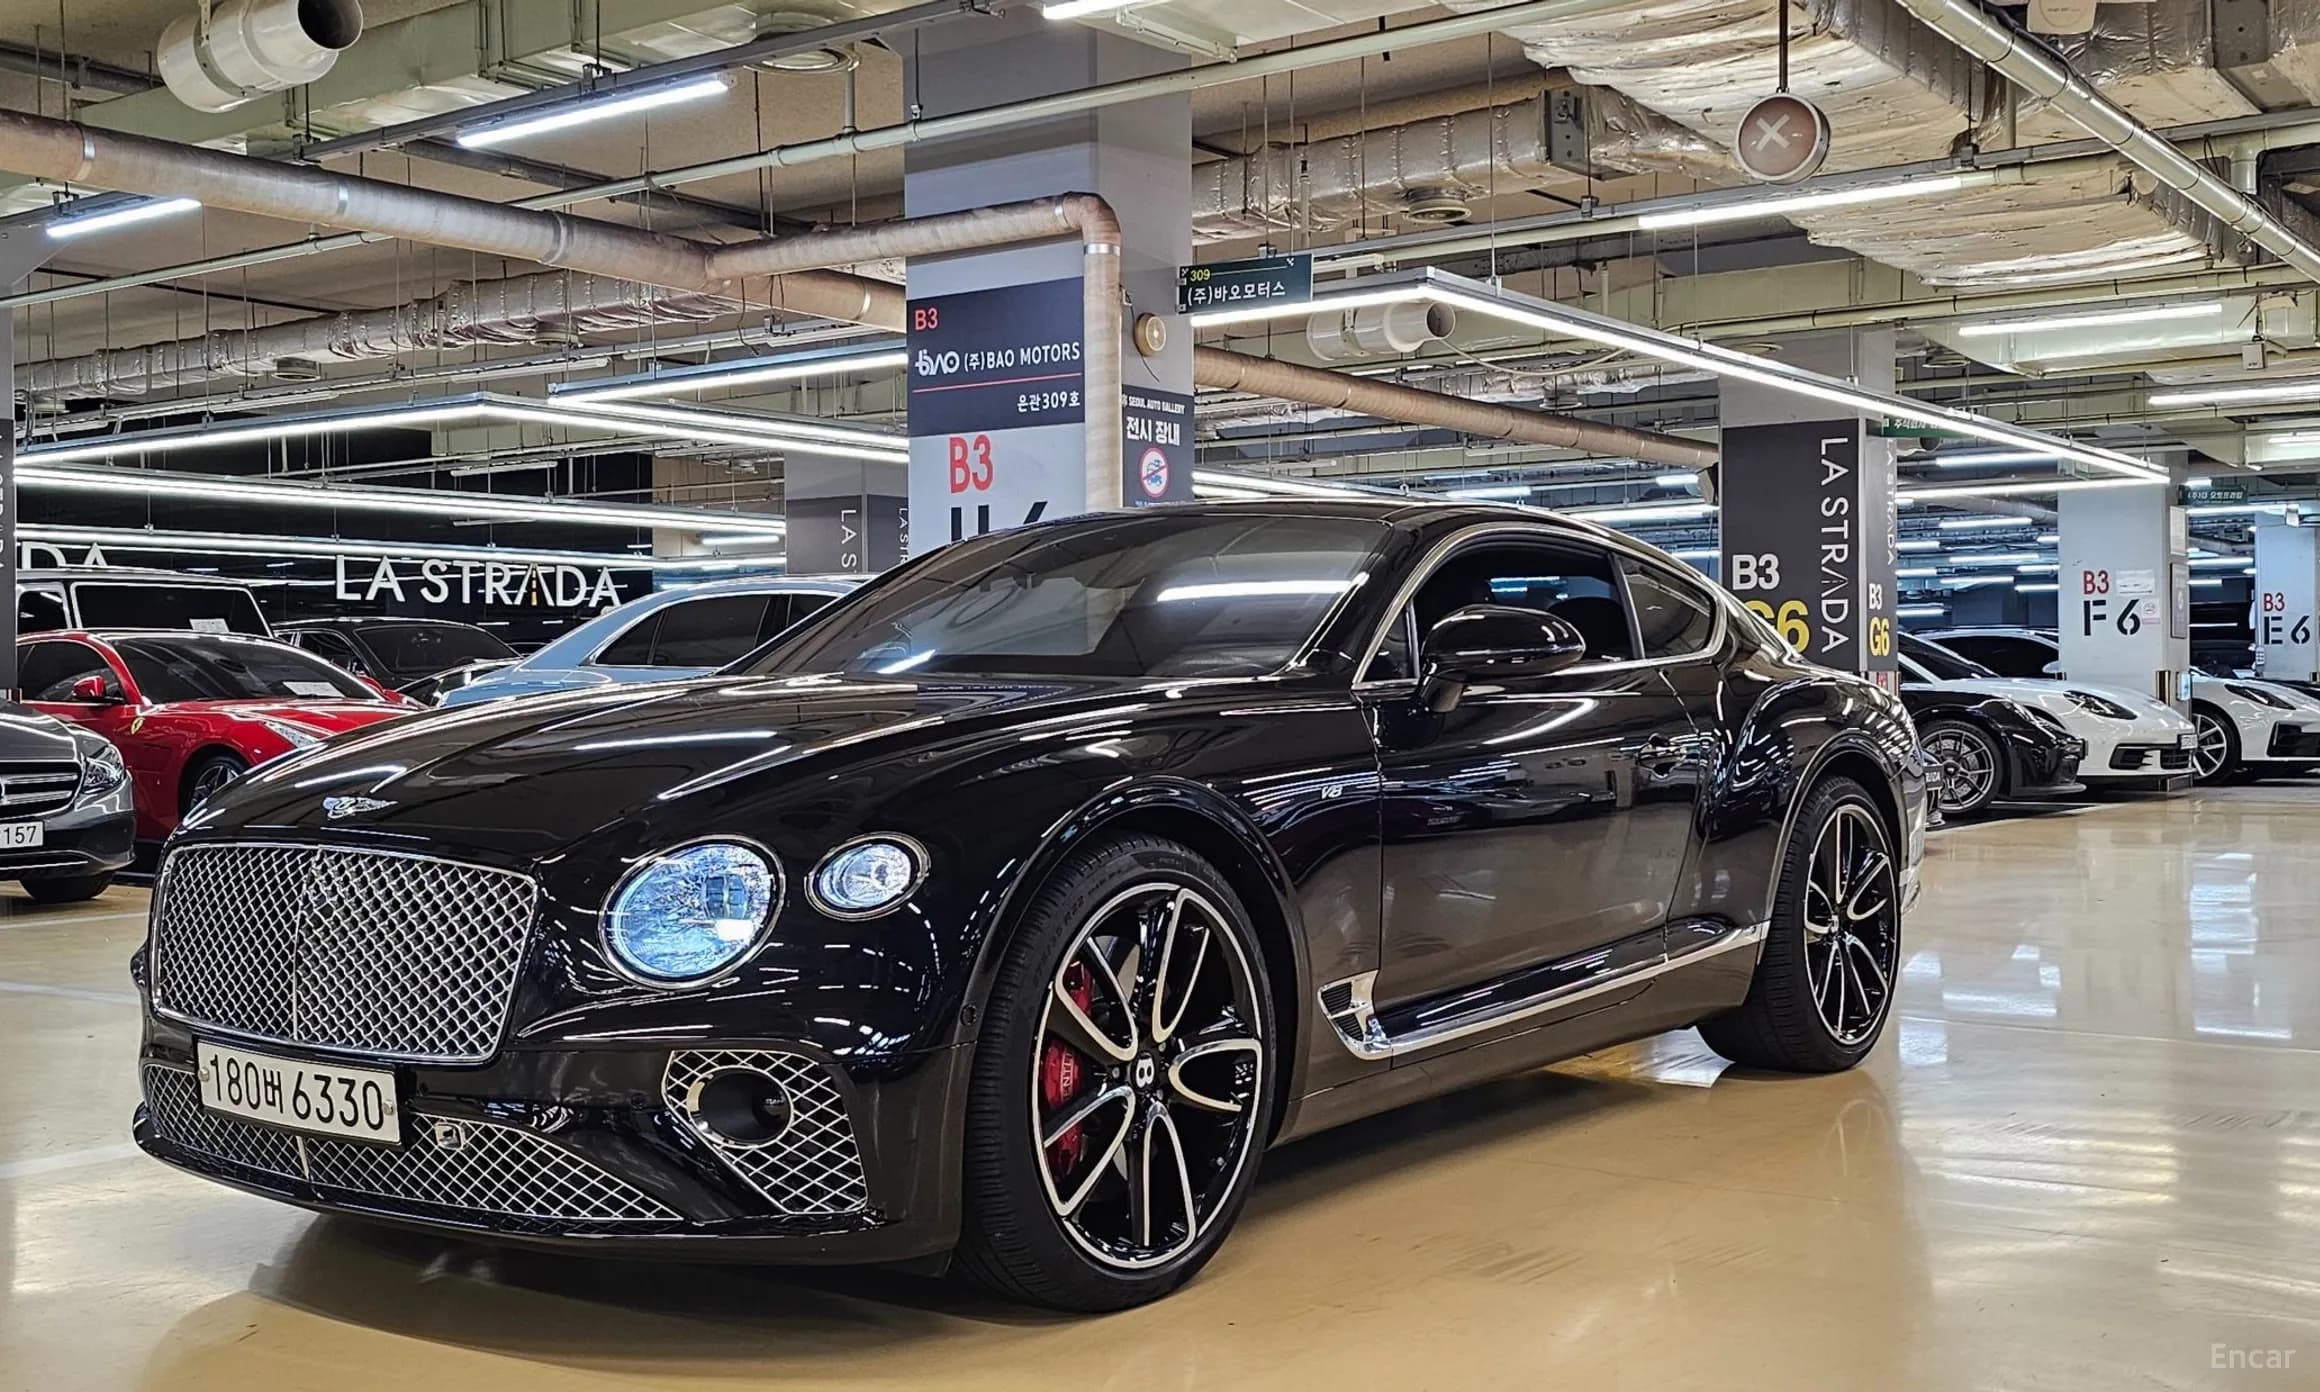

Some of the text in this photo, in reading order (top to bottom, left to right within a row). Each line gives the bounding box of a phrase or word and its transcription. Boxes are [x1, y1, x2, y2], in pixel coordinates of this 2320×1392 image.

[1190, 268, 1211, 282] 309
[1187, 281, 1286, 306] (주)바오모터스
[914, 308, 939, 331] B3
[1020, 341, 1081, 366] MOTORS
[1128, 396, 1185, 415] SEOUL AUTO GALLERY
[1126, 416, 1180, 447] 전시 장내
[950, 434, 993, 494] B3
[840, 509, 858, 545] LA
[1820, 438, 1849, 653] LA STRADA
[335, 554, 622, 608] LA STRADA
[1732, 553, 1781, 591] B3
[2083, 570, 2110, 595] B3
[1868, 583, 1883, 611] B3
[2263, 592, 2286, 612] B3
[1869, 616, 1891, 657] G6
[1321, 784, 1343, 800] V8
[3, 825, 37, 845] 157
[210, 1054, 384, 1131] 180버 6330
